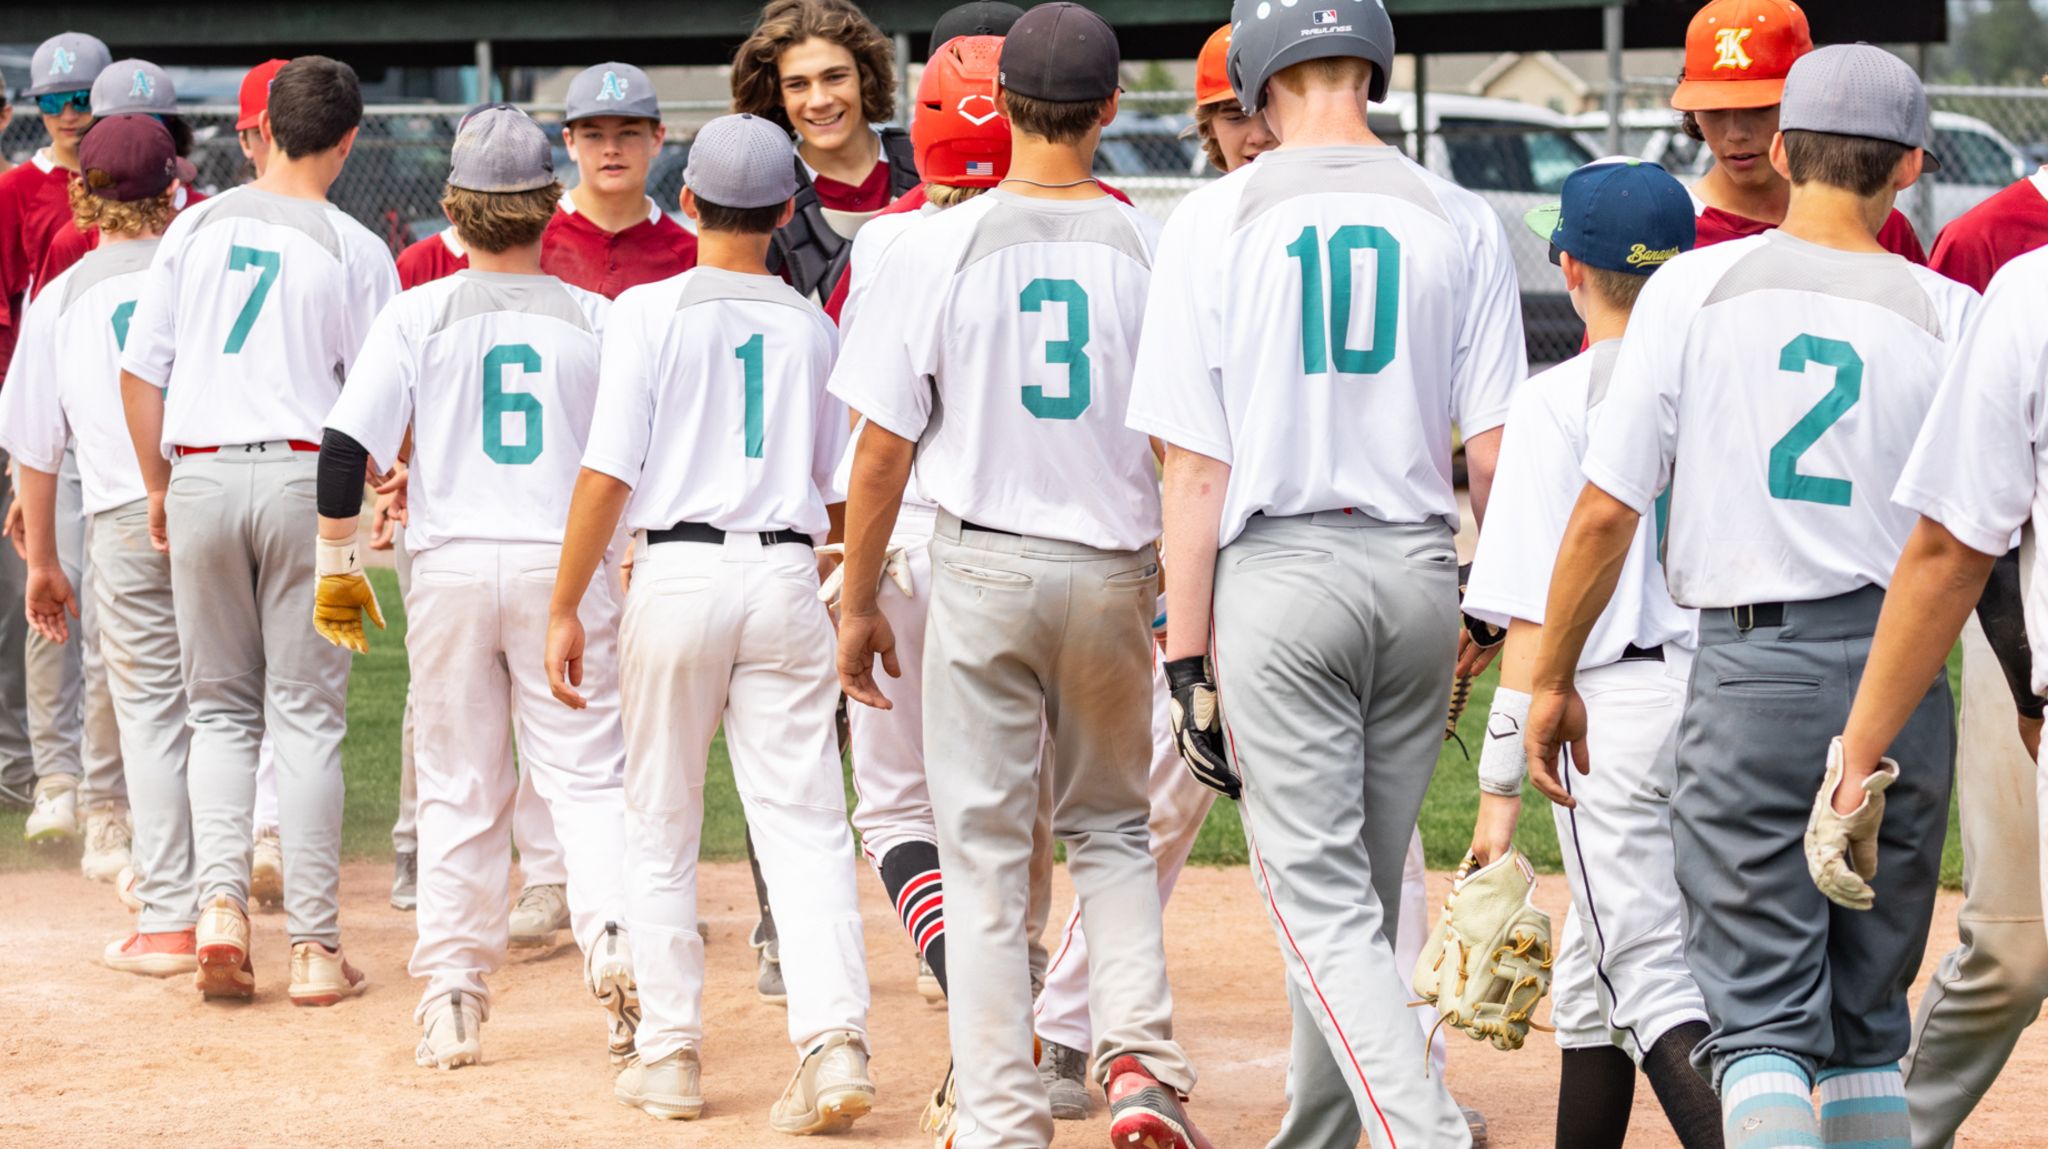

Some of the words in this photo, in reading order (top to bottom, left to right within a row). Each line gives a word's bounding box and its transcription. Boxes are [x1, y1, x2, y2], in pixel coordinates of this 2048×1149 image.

[1301, 25, 1353, 36] RAWLINGS
[1712, 27, 1754, 71] K
[223, 244, 281, 354] 7
[1019, 278, 1091, 420] 3
[1286, 225, 1400, 375] 10
[482, 344, 543, 465] 6
[733, 334, 765, 458] 1
[1767, 333, 1864, 507] 2
